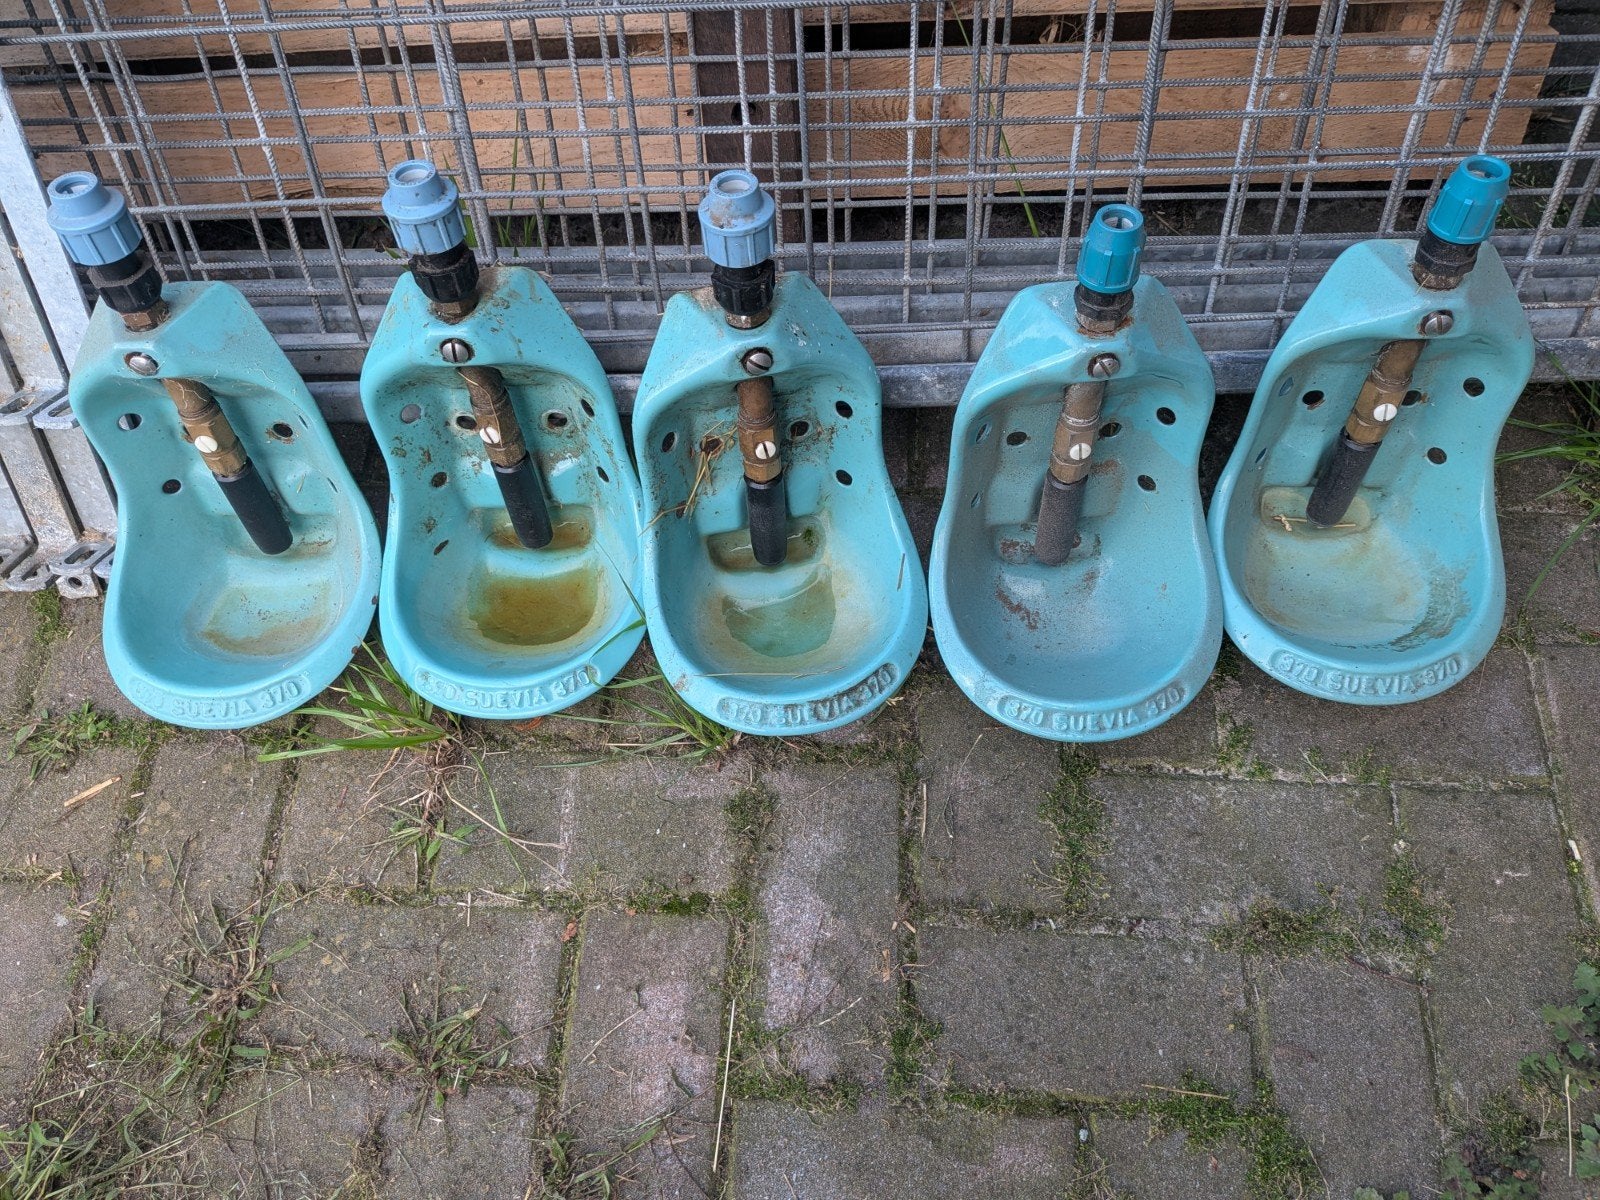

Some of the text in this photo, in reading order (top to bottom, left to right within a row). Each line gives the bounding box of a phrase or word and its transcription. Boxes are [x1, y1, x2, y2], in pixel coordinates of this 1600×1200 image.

[464, 688, 549, 709] SUEVIA
[552, 668, 590, 698] 370
[1282, 655, 1461, 696] 370 SUEVIA 370
[171, 699, 255, 718] SUEVIA
[262, 680, 301, 709] 370
[1005, 688, 1181, 731] 370 SUEVIA 370
